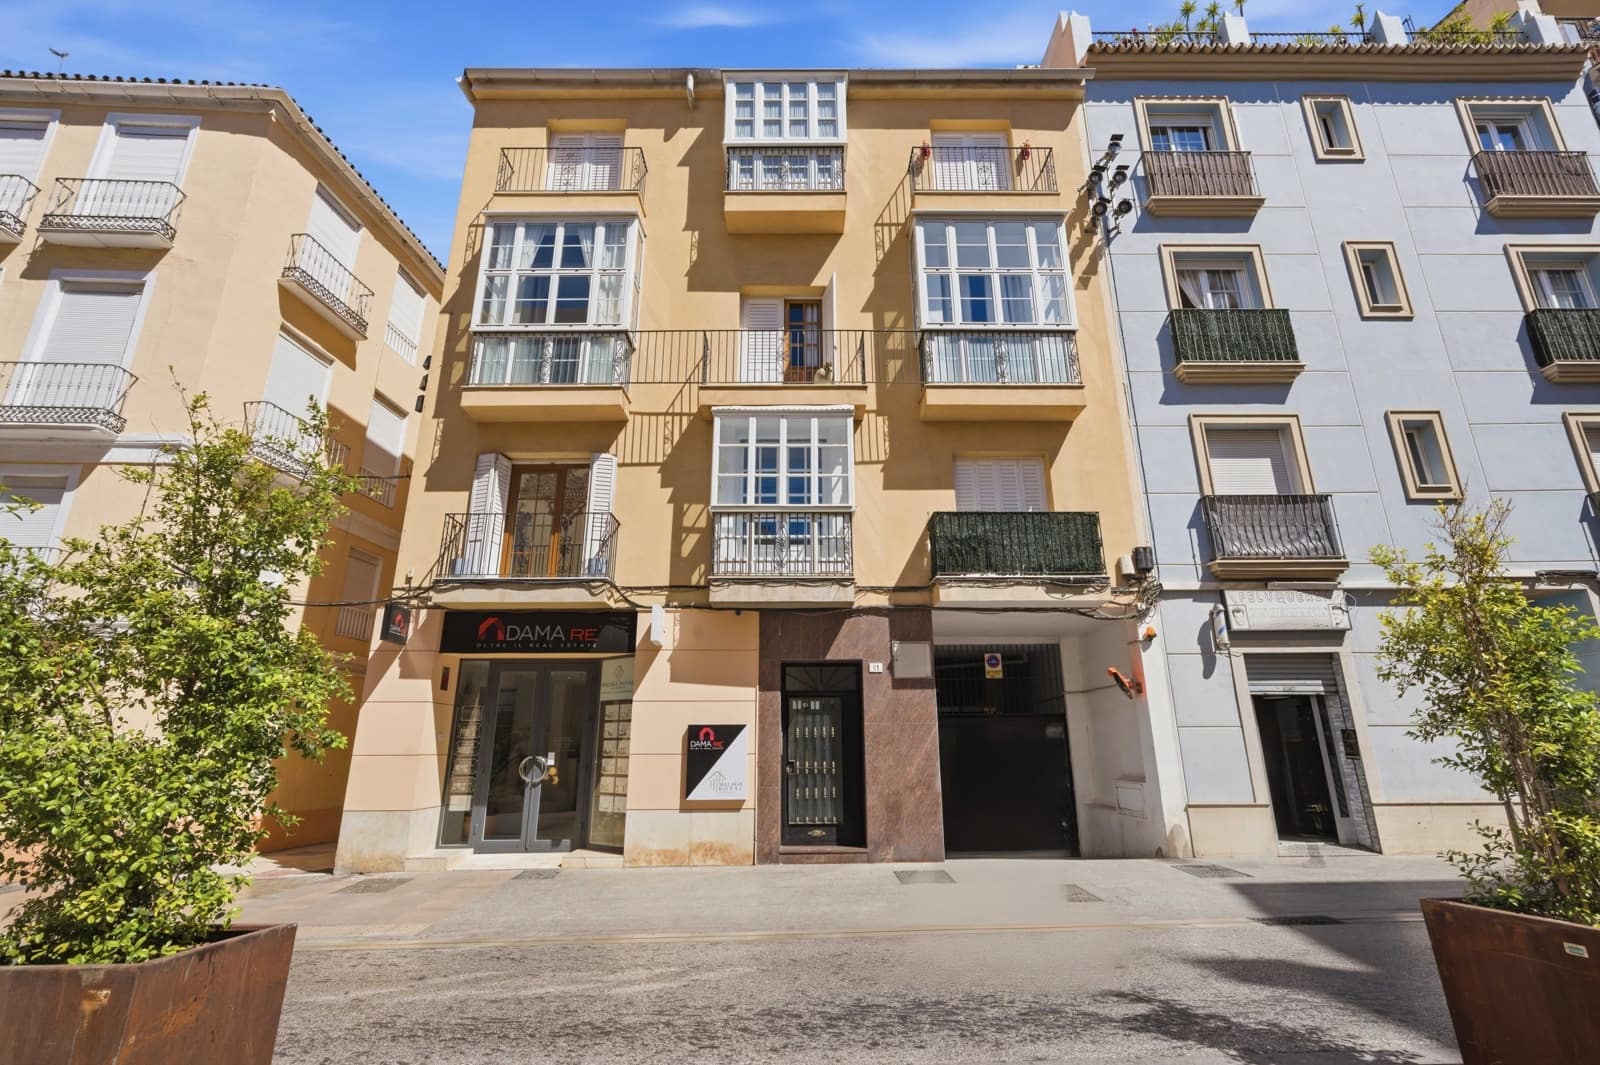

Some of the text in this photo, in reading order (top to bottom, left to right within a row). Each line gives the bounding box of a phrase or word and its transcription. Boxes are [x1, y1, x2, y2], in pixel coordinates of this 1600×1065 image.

[1238, 591, 1329, 604] PELUQUER
[505, 625, 598, 641] DAMA RE
[690, 740, 712, 748] DAMA
